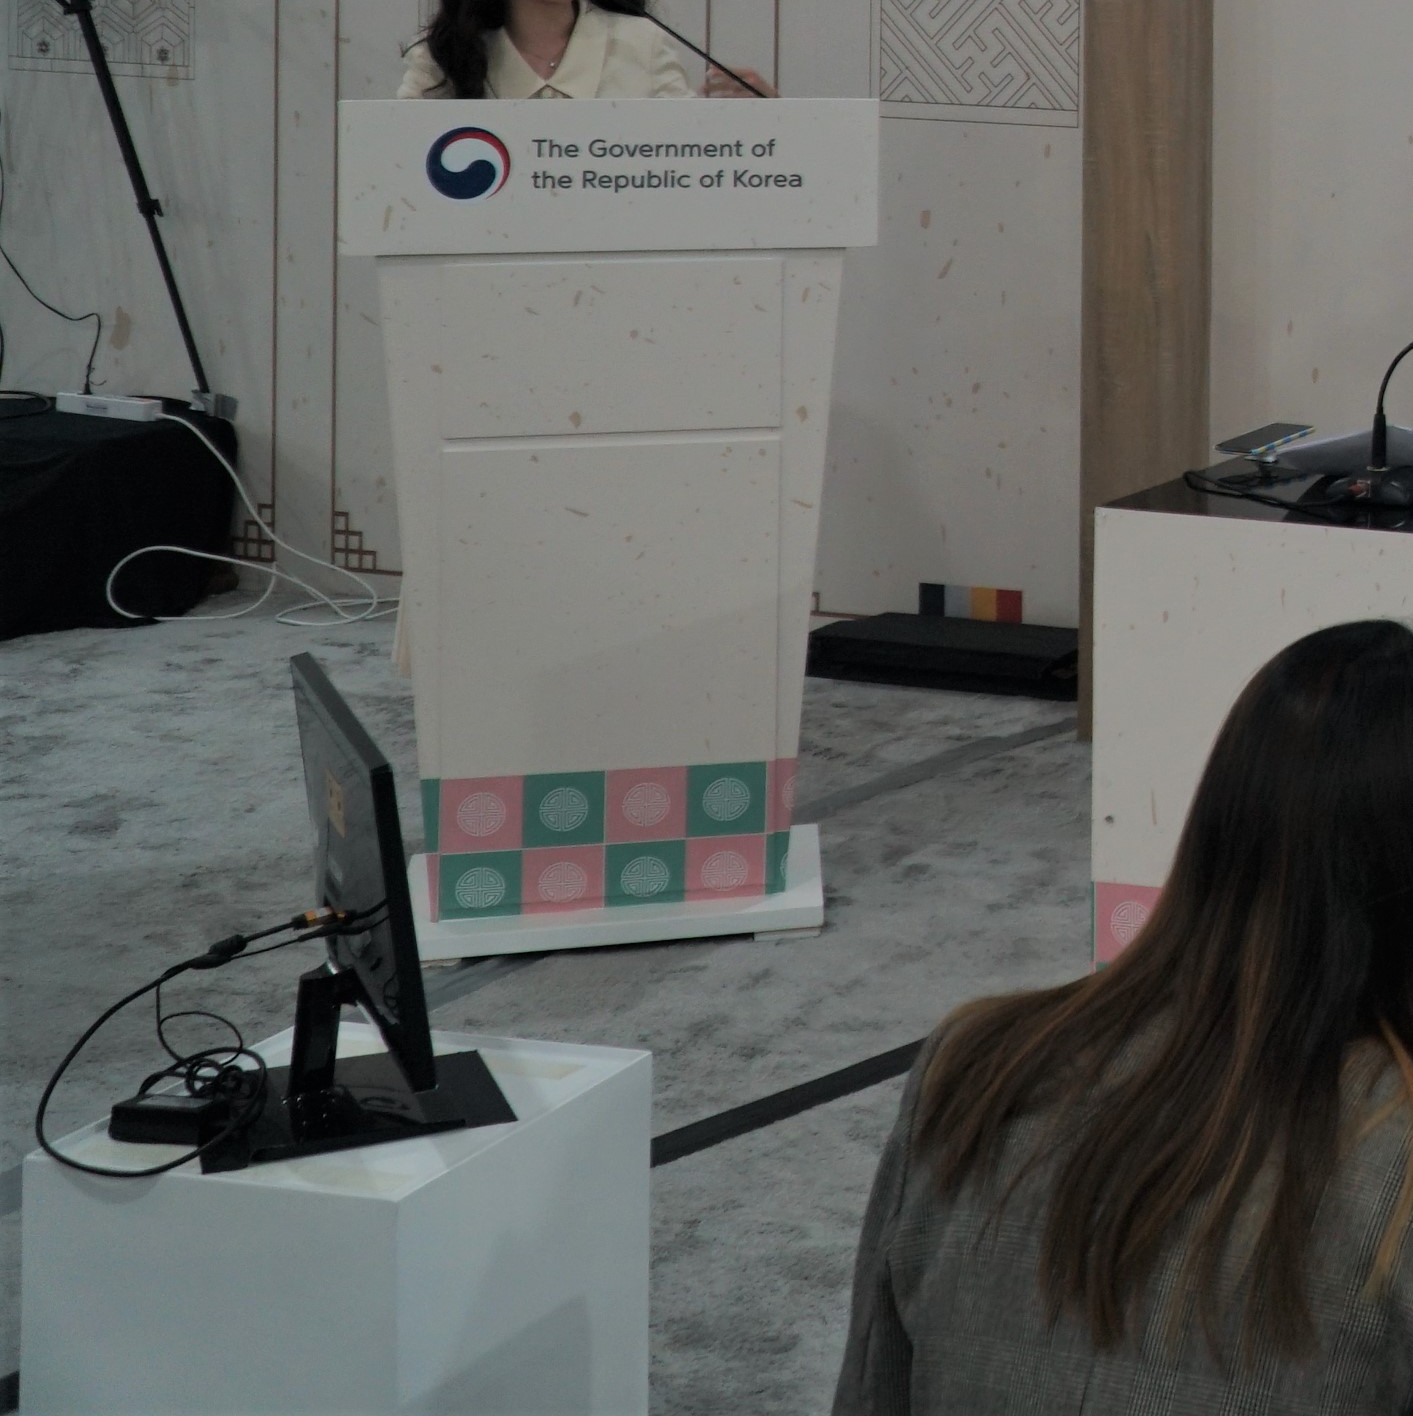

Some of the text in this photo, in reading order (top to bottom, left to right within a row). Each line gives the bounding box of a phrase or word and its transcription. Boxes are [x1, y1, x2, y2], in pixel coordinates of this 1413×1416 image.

[532, 138, 776, 159] The Government of
[531, 169, 803, 193] the Republic of Korea
